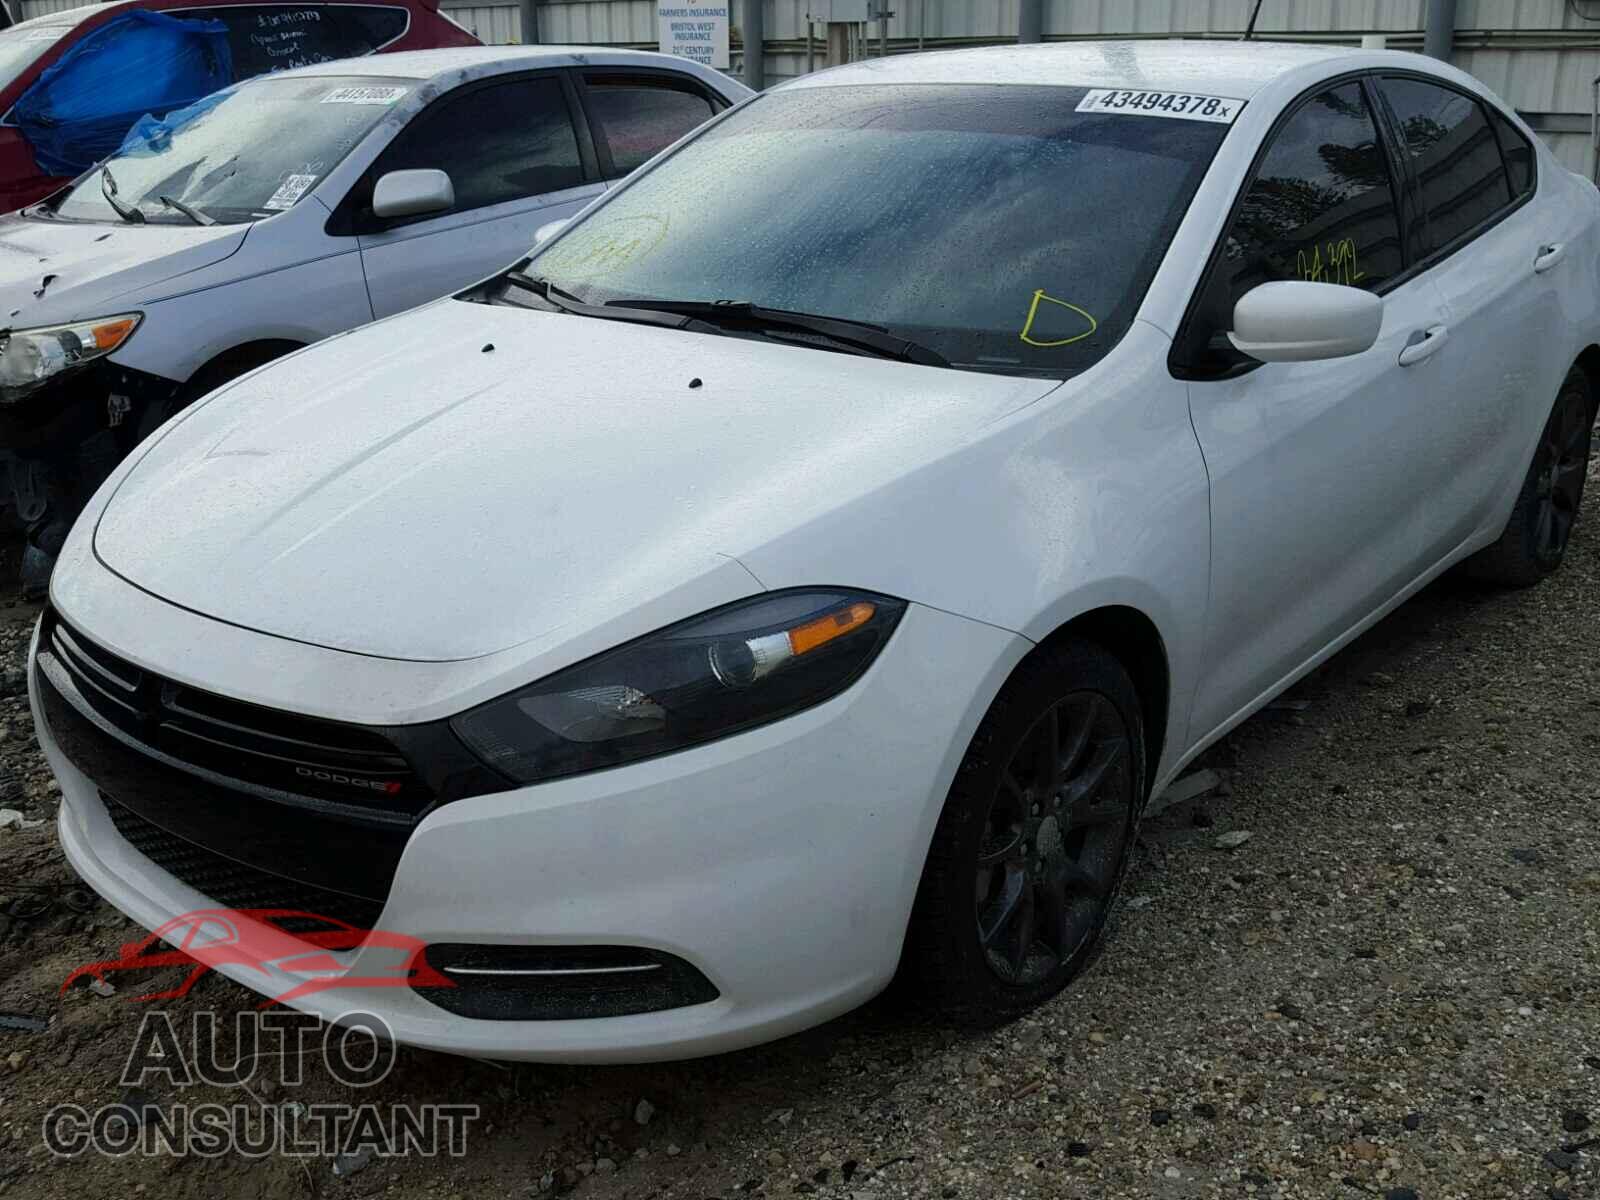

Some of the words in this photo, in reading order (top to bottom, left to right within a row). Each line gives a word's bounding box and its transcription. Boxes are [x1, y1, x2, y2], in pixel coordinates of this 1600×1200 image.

[659, 8, 688, 17] FARMERS
[689, 8, 727, 17] INSURANCE
[671, 23, 695, 31] BRISTOL
[696, 23, 715, 31] WEST
[674, 32, 712, 41] INSURANCE
[686, 46, 714, 55] CENTURY
[295, 766, 386, 791] DODGE
